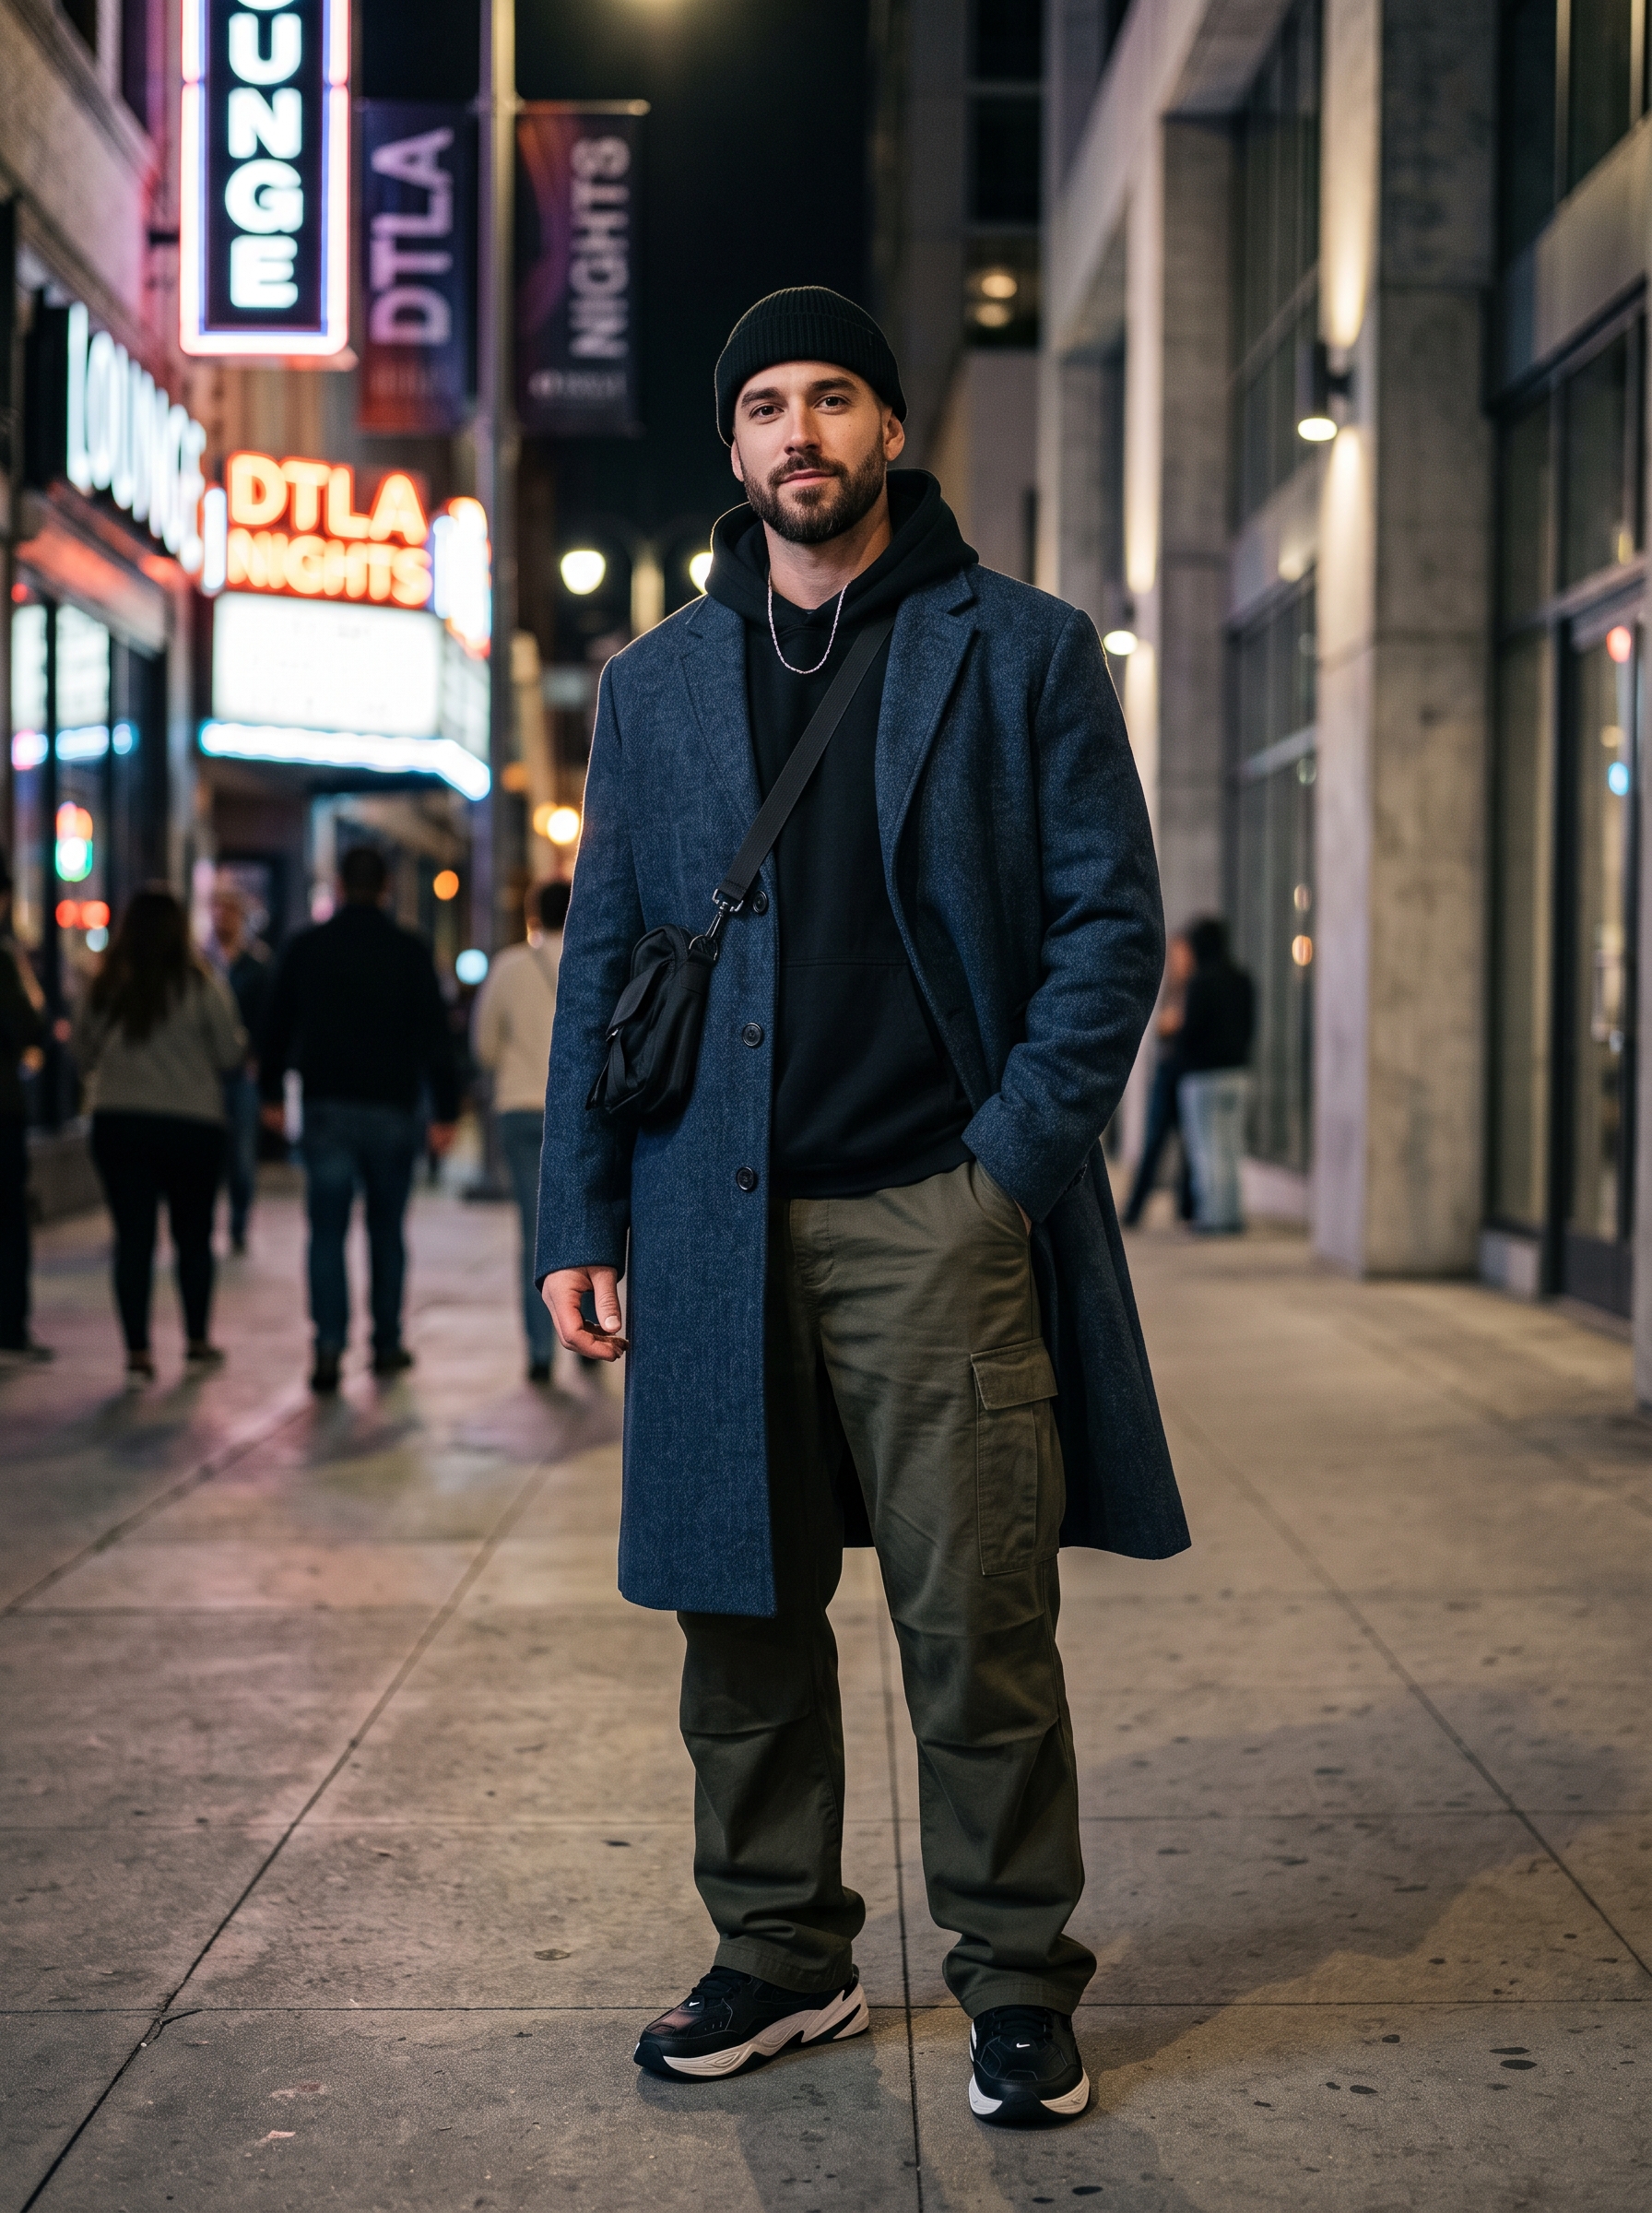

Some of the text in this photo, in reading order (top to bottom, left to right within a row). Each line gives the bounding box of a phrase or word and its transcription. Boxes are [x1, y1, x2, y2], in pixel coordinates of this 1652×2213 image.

[227, 0, 303, 308] UNGE
[372, 127, 453, 345] DTLA
[569, 136, 631, 360] NIGHTS
[228, 451, 427, 546] DTLA
[228, 527, 433, 606] NIGHTS
